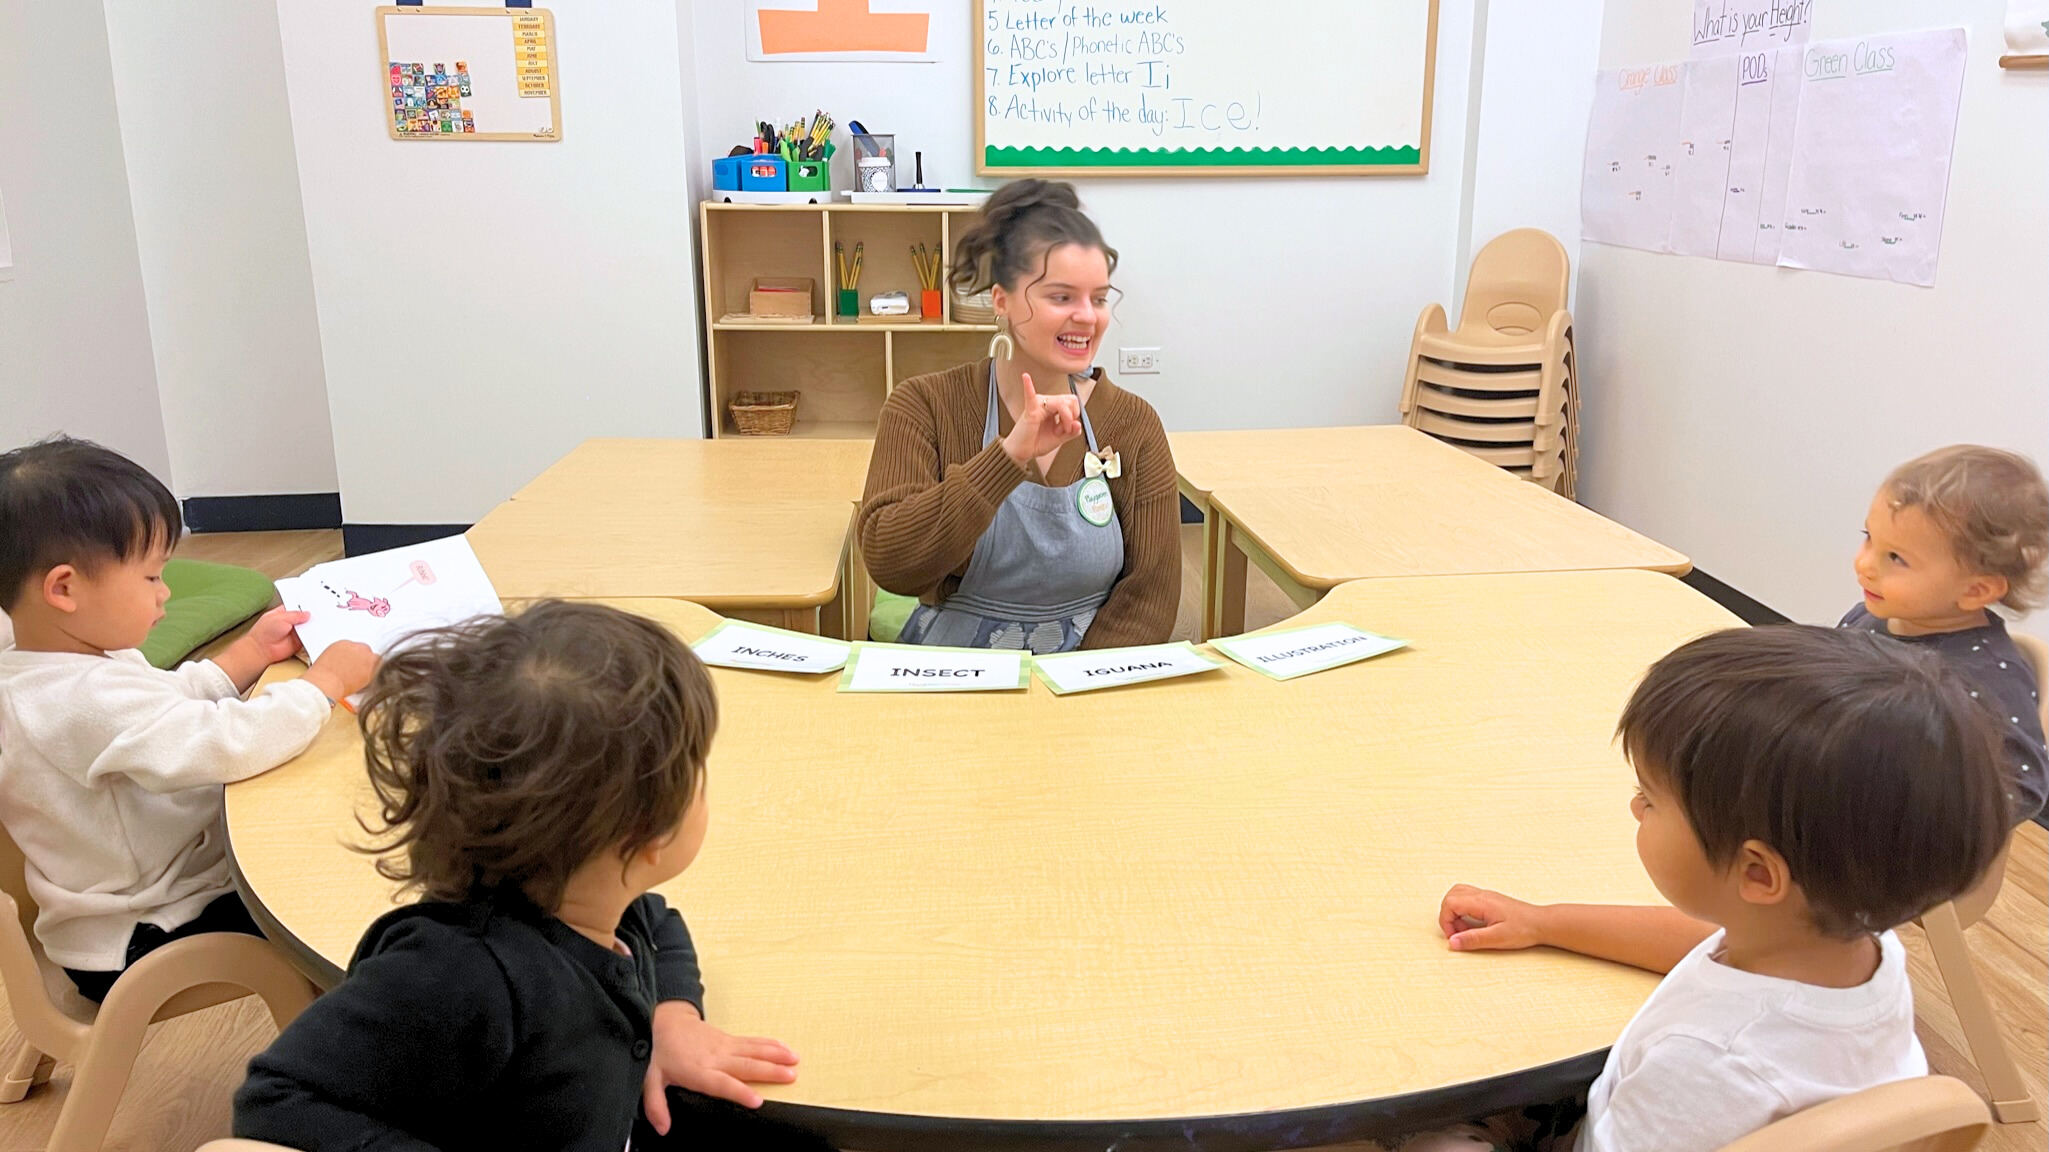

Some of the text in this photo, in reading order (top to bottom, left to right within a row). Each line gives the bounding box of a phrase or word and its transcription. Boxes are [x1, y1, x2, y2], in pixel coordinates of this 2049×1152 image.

[988, 10, 999, 31] 5
[1006, 9, 1056, 31] Letter
[1063, 5, 1079, 27] of
[1082, 6, 1112, 28] the
[1120, 5, 1168, 24] week
[1693, 0, 1810, 47] What is your Height?
[987, 38, 1003, 55] 6.
[1010, 33, 1058, 60] ABC's
[1138, 30, 1185, 55] ABC's
[1741, 53, 1768, 80] PODs
[1804, 41, 1895, 78] Green Class
[986, 66, 1000, 87] 7.
[1008, 63, 1077, 92] Explore
[1086, 61, 1133, 86] letter
[1653, 64, 1678, 86] Class
[987, 94, 1001, 116] 8.
[1004, 94, 1073, 128] Activity
[1078, 96, 1098, 121] of
[1102, 99, 1131, 123] the
[1138, 92, 1169, 136] day:
[731, 645, 810, 663] INCHES
[1255, 634, 1369, 664] ILLUSTRATION
[890, 667, 986, 678] INSECT
[1083, 660, 1174, 678] IGUANA
